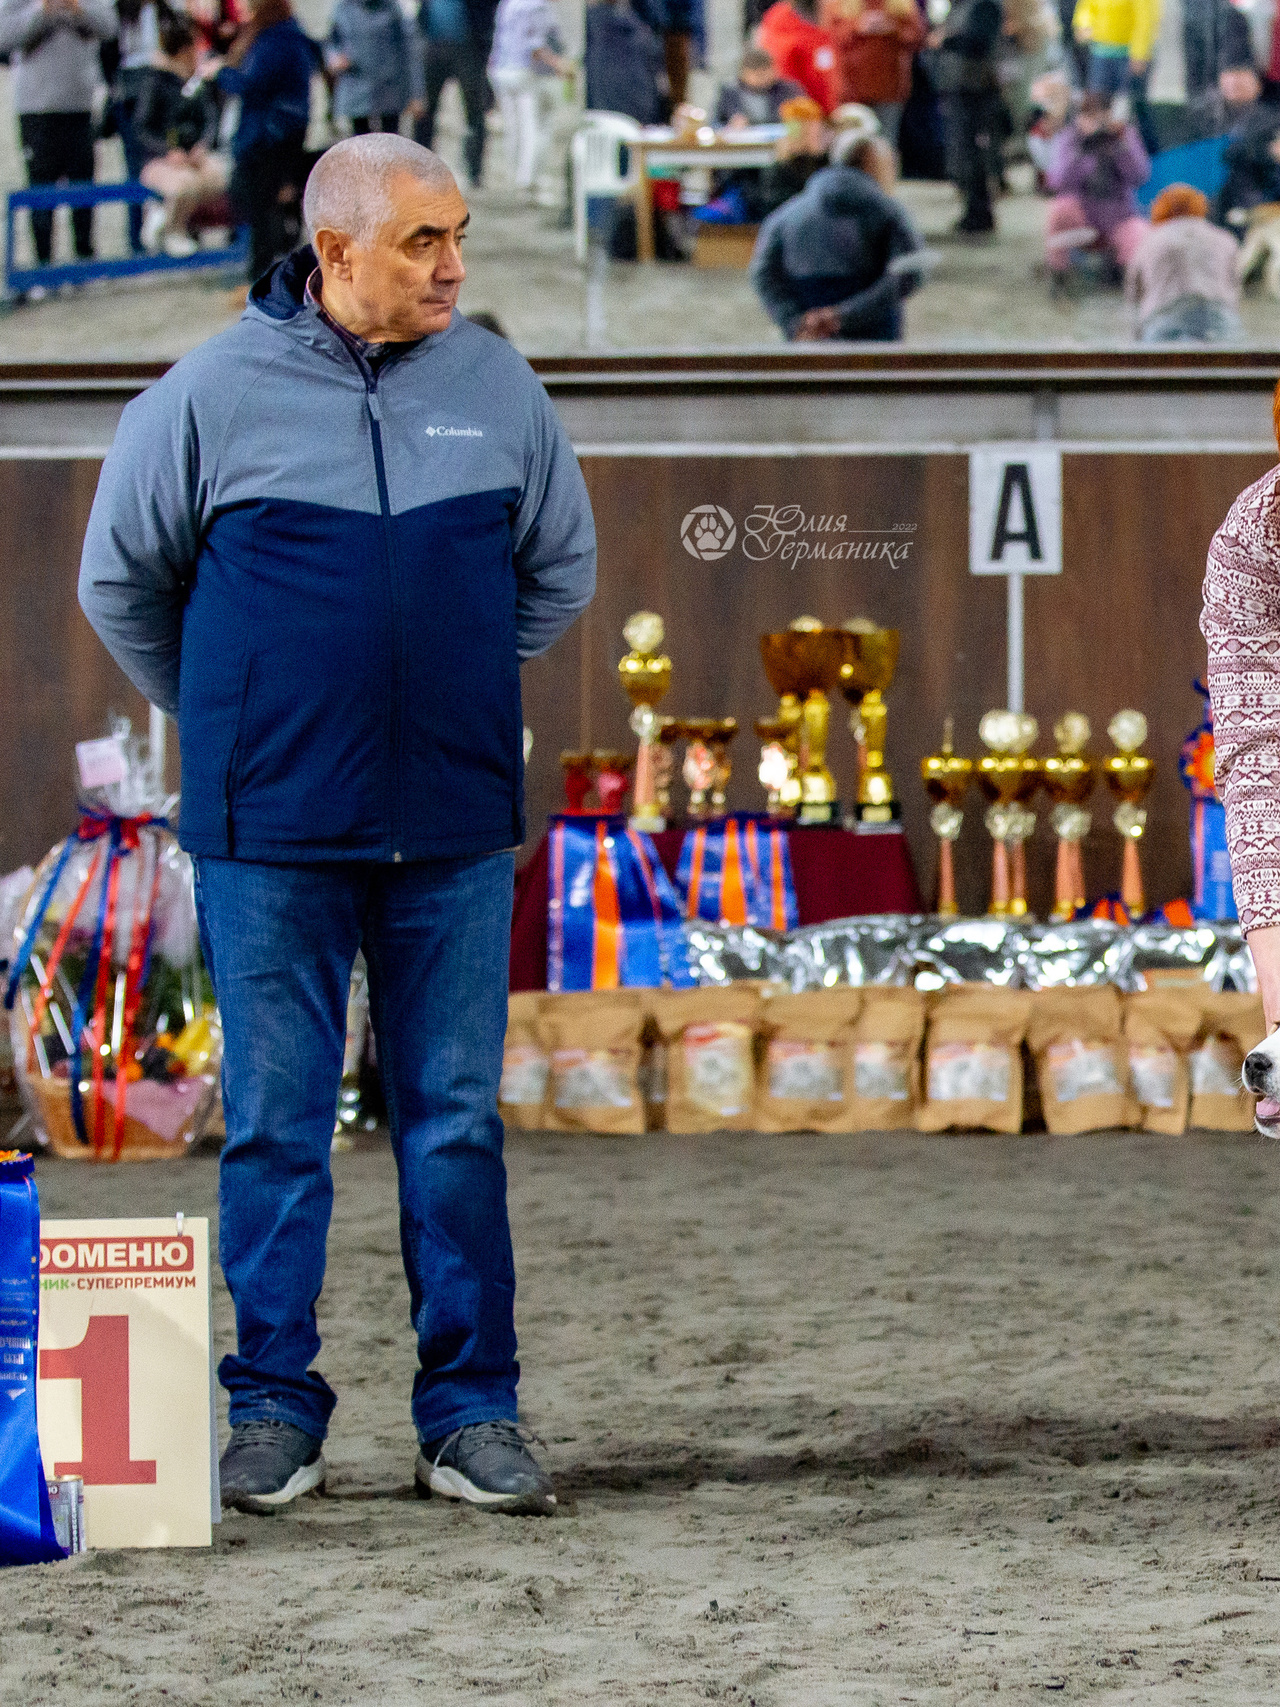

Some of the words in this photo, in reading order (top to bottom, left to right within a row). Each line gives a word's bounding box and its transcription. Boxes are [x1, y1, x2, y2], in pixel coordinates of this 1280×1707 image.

[436, 425, 483, 437] Columbia
[990, 463, 1042, 561] A
[40, 1241, 188, 1269] ОМЕНЮ
[40, 1315, 157, 1486] 1
